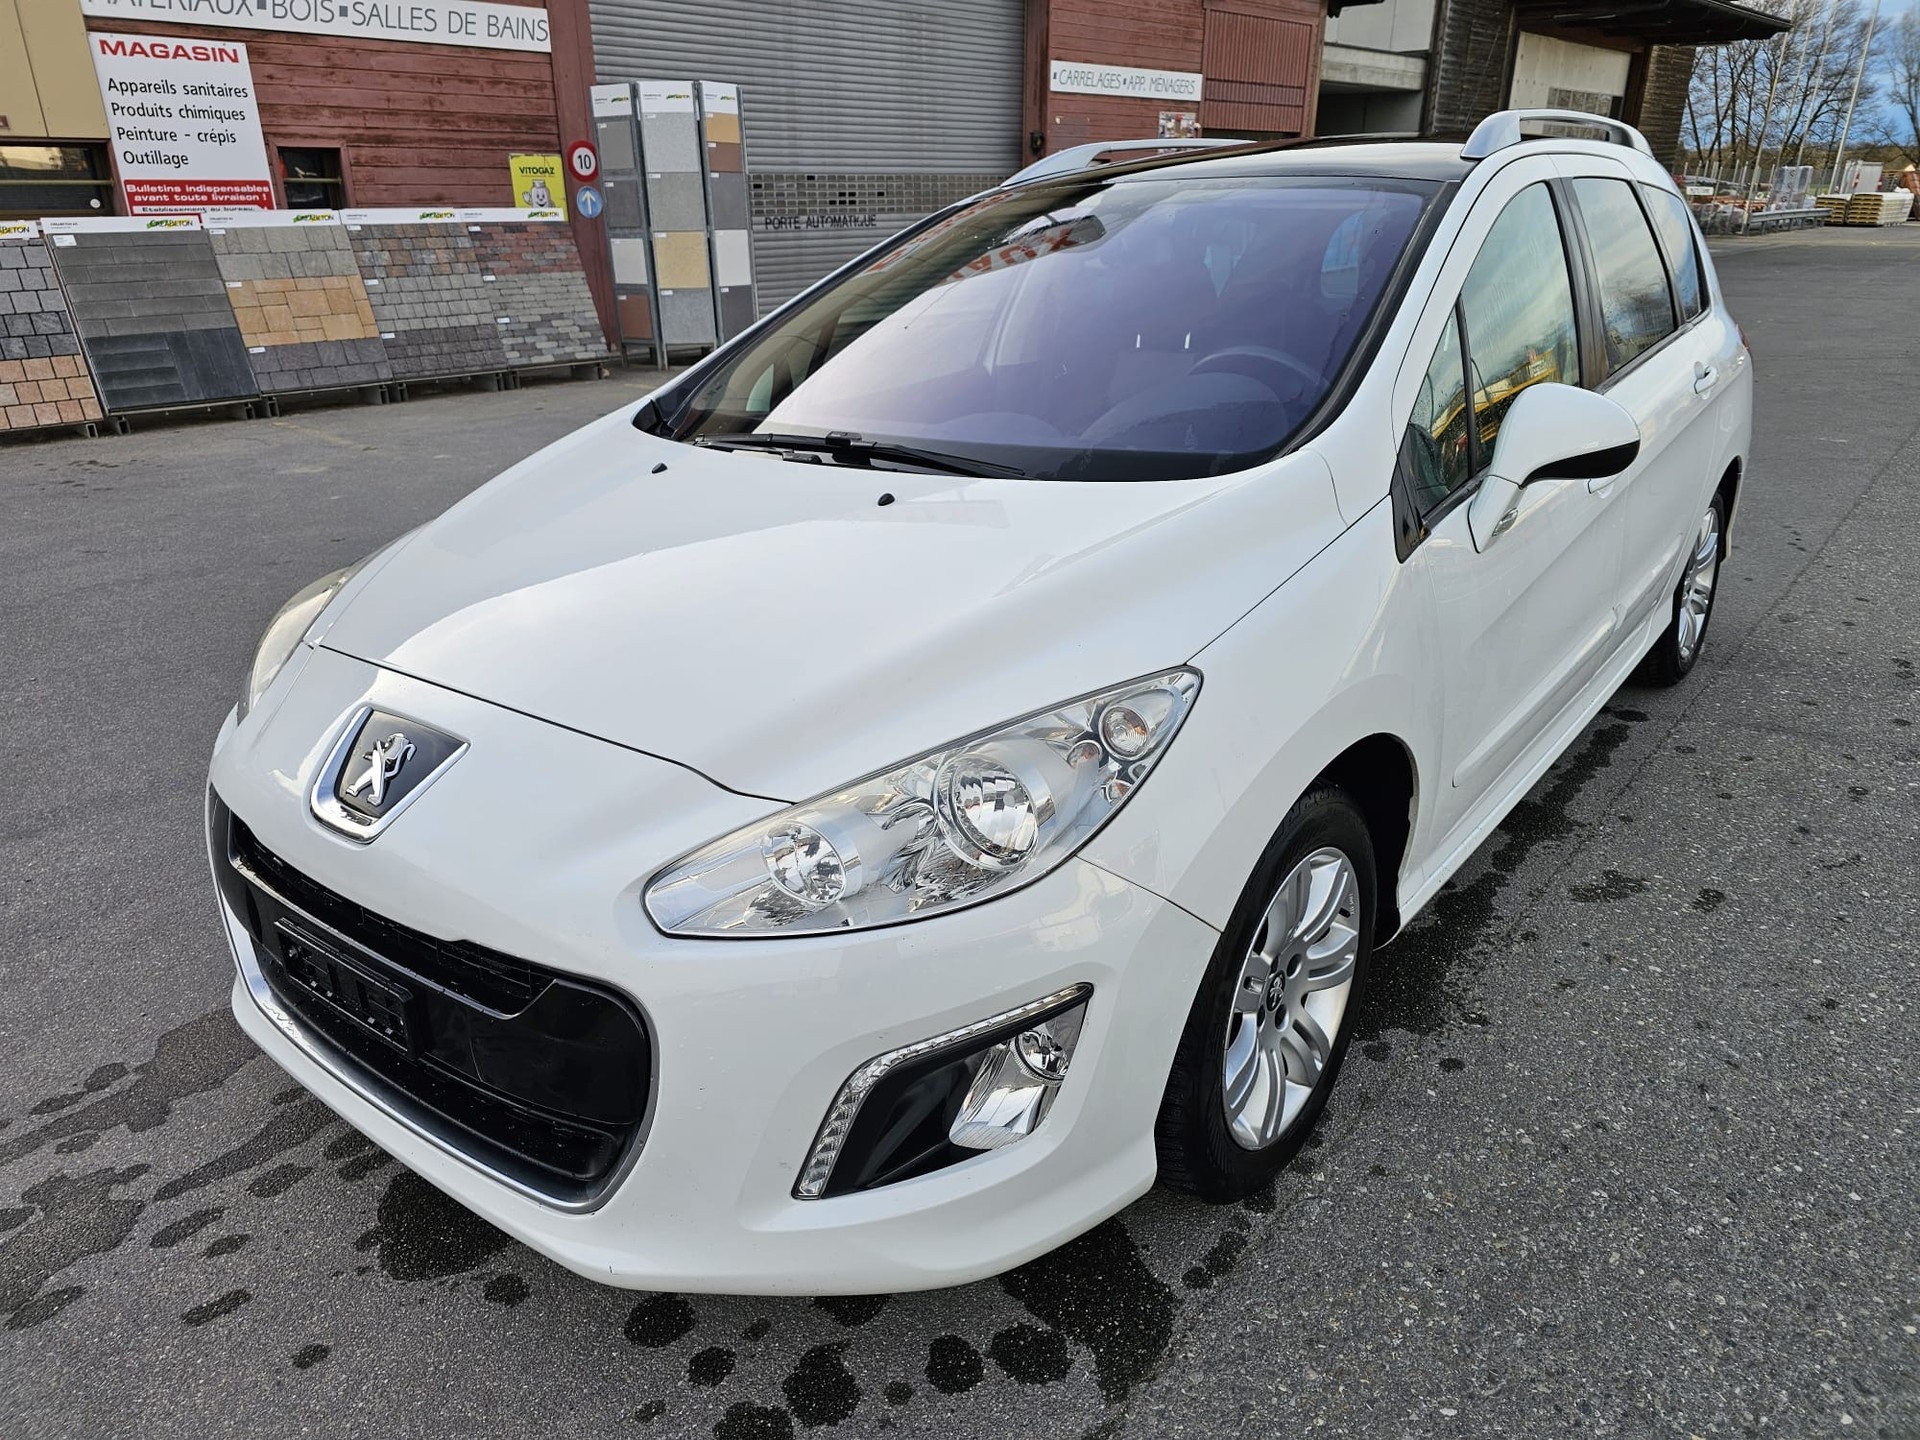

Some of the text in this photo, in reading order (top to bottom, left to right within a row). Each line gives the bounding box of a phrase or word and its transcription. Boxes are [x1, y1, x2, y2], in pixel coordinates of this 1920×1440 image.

[271, 0, 335, 24] BOIS
[351, 2, 438, 32] SALLES
[448, 10, 477, 36] DE
[487, 15, 549, 42] BAINS
[99, 39, 240, 64] MAGASIN
[107, 77, 248, 98] Appareils sanitaires
[1059, 68, 1122, 89] CARRELAGES
[1127, 75, 1146, 91] APP.
[111, 102, 246, 123] Produits chimiques
[117, 126, 178, 142] Peinture
[197, 128, 237, 146] crépis
[123, 150, 189, 168] Outillage
[577, 154, 592, 170] 10
[519, 166, 555, 175] VITOGAZ
[126, 184, 270, 194] Bulletins indispensables
[212, 193, 259, 201] livraison
[0, 225, 30, 234] BETON
[765, 214, 877, 230] PORTE AUTOMATIUE
